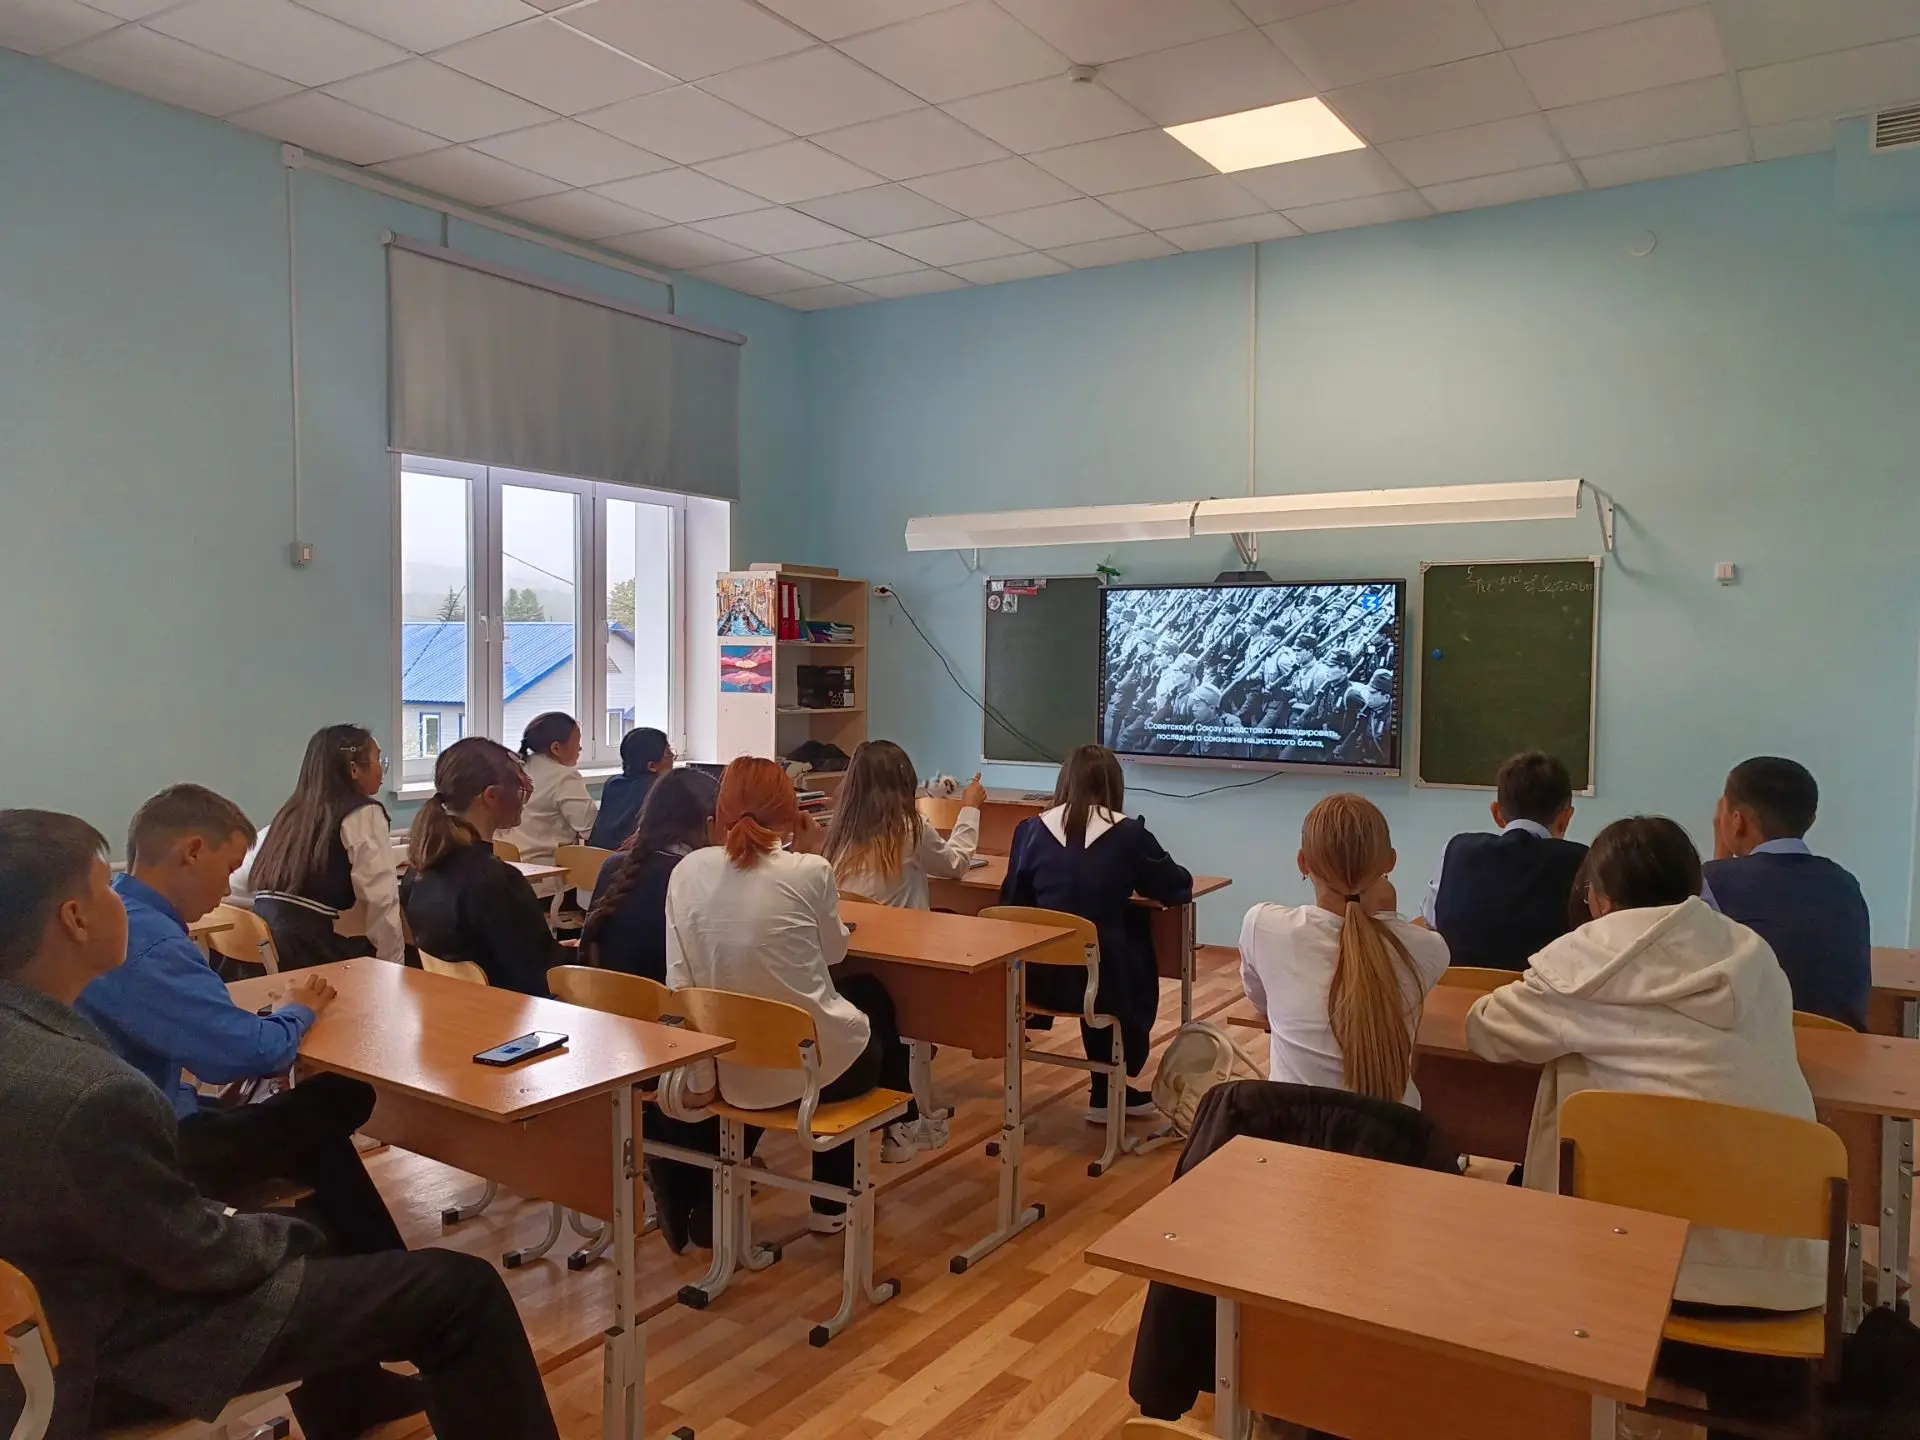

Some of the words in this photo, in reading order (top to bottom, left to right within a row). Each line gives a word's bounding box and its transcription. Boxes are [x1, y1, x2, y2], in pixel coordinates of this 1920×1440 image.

[1147, 722, 1194, 732] Советскому
[1195, 724, 1223, 733] Союзу
[1224, 726, 1273, 735] предстояло
[1156, 733, 1202, 742] последнего
[1243, 737, 1296, 746] нацистского
[1297, 738, 1325, 748] блока,
